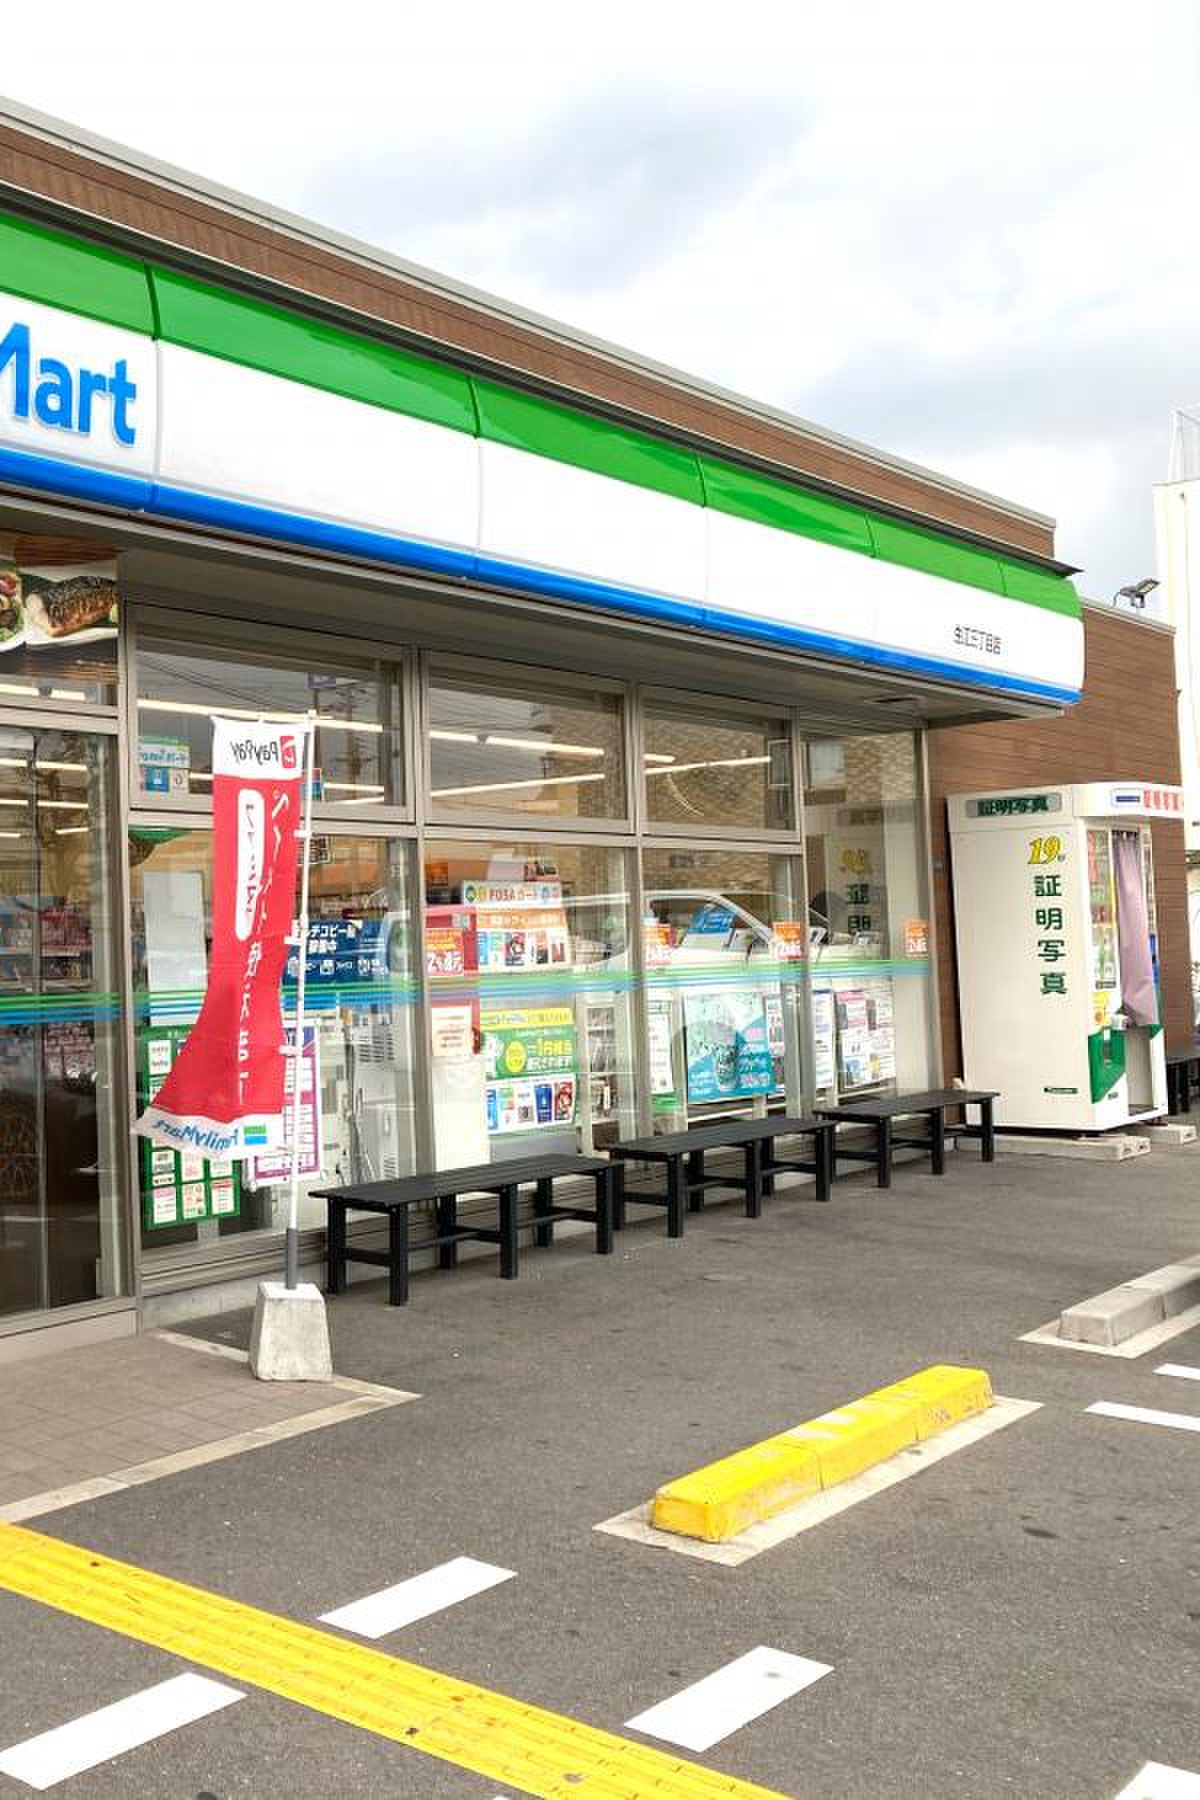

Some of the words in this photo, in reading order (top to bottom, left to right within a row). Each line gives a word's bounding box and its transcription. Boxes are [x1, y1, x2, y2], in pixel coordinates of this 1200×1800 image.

[977, 795, 1049, 816] 証明写真
[1033, 874, 1068, 995] 証明写真
